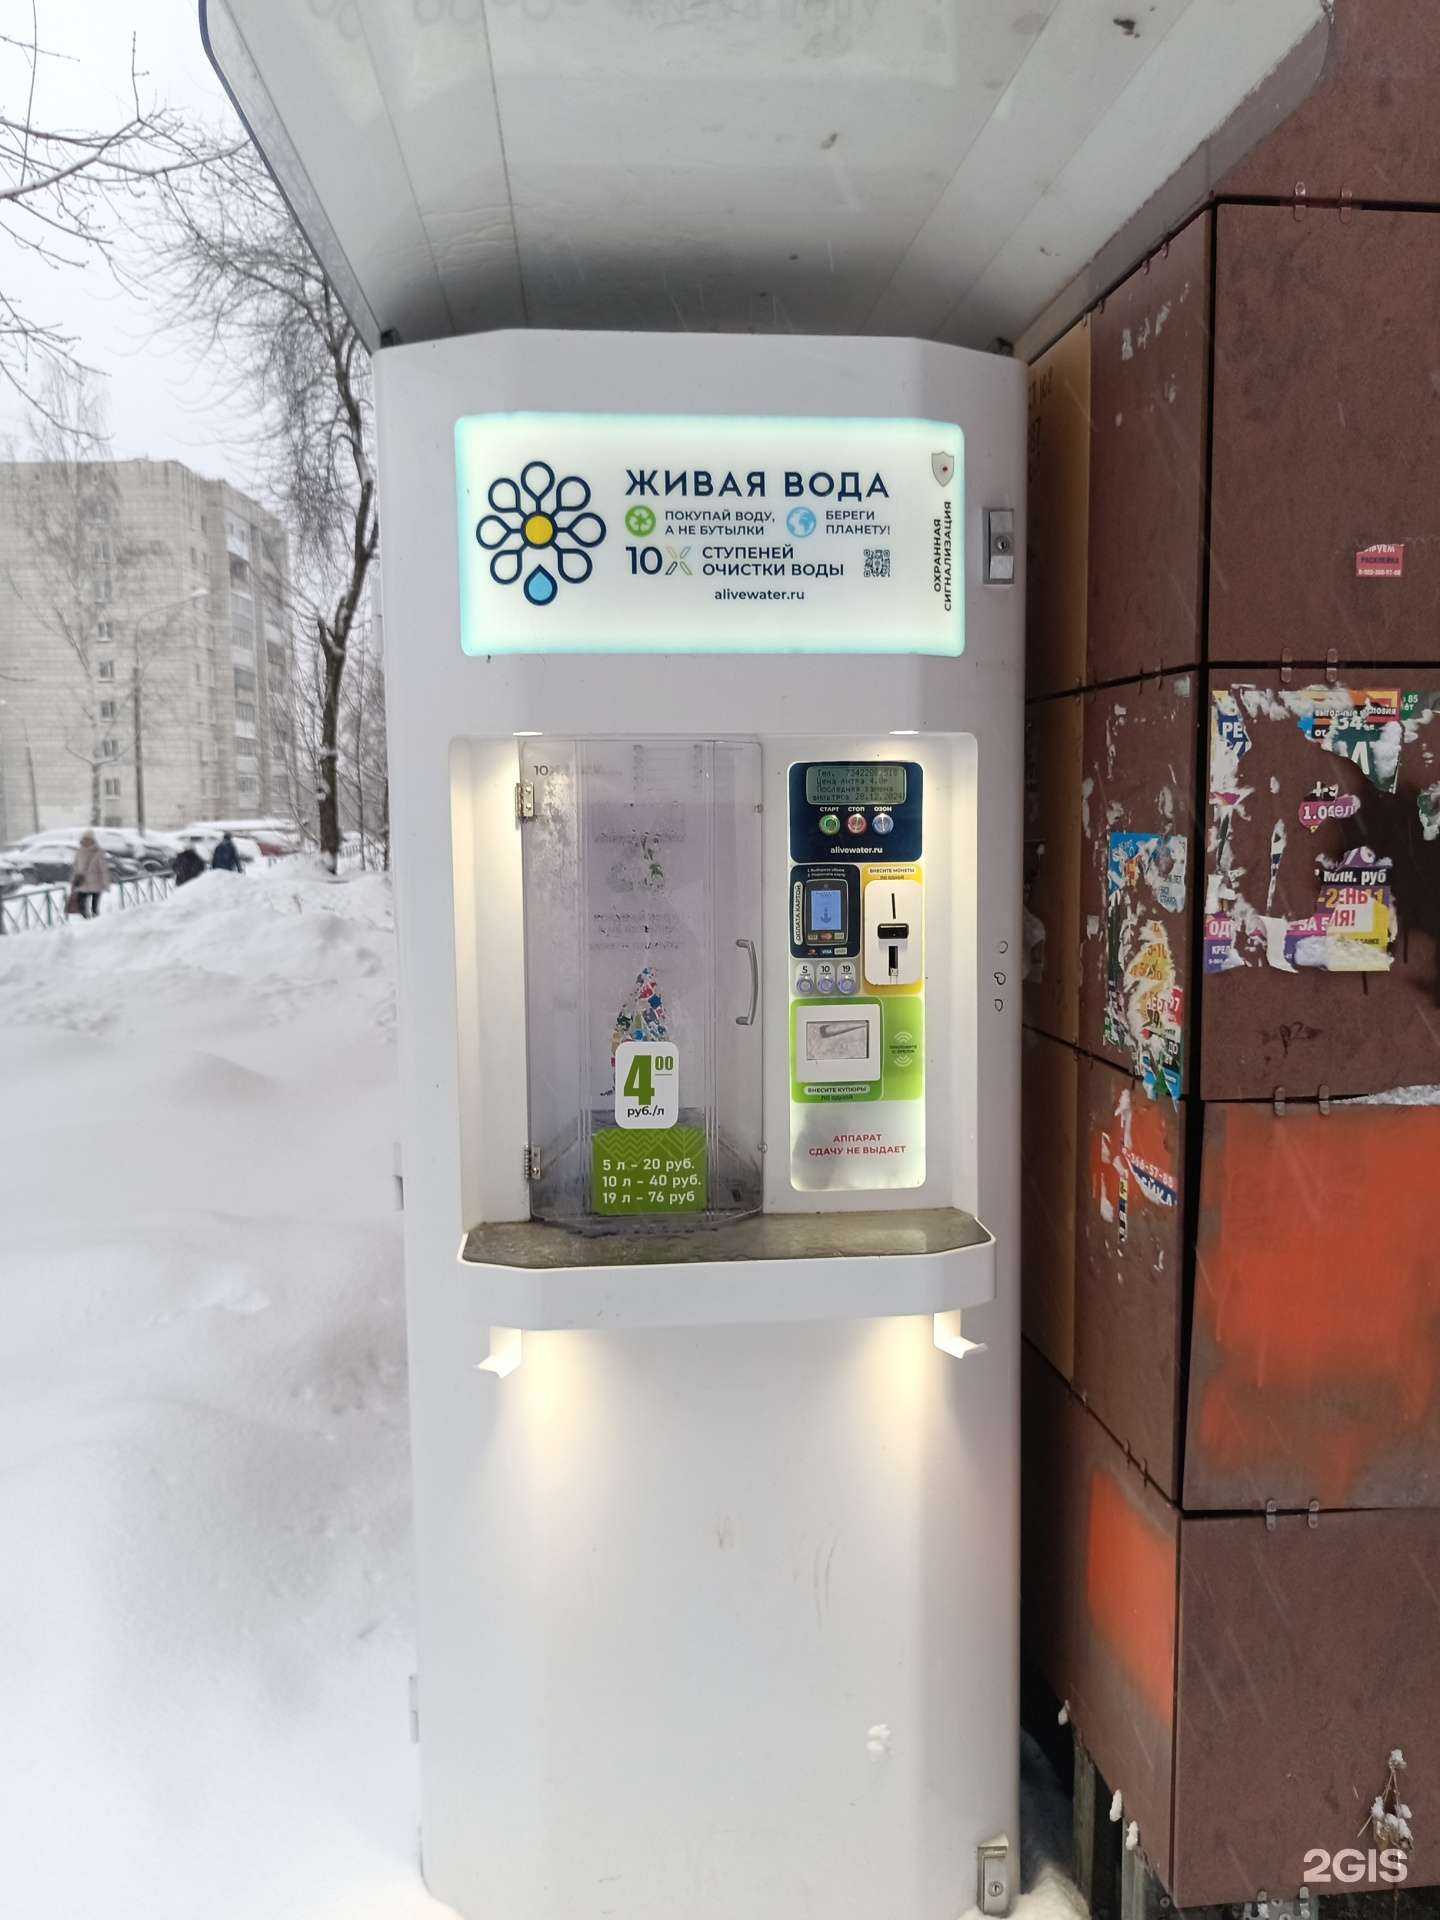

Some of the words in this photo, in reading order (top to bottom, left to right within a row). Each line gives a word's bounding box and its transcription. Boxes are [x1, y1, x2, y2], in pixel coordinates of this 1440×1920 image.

[625, 469, 766, 497] ЖИВАЯ
[784, 471, 889, 502] ВОДА
[665, 509, 731, 521] ПОКУПАЙ
[735, 511, 775, 523] ВОДУ,
[826, 510, 875, 520] БЕРЕГИ
[665, 525, 674, 535] А
[679, 526, 696, 535] НЕ
[700, 526, 764, 535] БУТЫЛКИ
[826, 524, 890, 535] ПЛАНЕТУ!
[702, 544, 794, 559] СТУПЕНЕЙ
[944, 501, 952, 611] СИГНАЛИЗАЦИЯ
[702, 563, 785, 576] ОЧИСТКИ
[791, 563, 844, 577] ВОДЫ
[714, 588, 805, 600] alivewater.ru
[533, 765, 549, 776] 10
[830, 846, 883, 854] alivewater.ru
[802, 965, 808, 973] 5
[821, 965, 830, 973] 10
[842, 965, 850, 973] 19
[623, 1055, 655, 1105] 4
[627, 1105, 665, 1118] руб./л
[833, 1134, 882, 1143] АППАРАТ
[809, 1147, 844, 1156] СДАЧУ
[847, 1146, 860, 1154] НЕ
[863, 1145, 906, 1155] ВЫДАЕТ
[603, 1159, 611, 1171] 5
[616, 1161, 625, 1171] л
[643, 1158, 660, 1170] 20
[666, 1158, 695, 1172] руб.
[602, 1175, 617, 1188] 10
[622, 1178, 631, 1188] л
[649, 1174, 667, 1186] 40
[672, 1174, 701, 1188] руб.
[603, 1192, 616, 1204] 19
[622, 1194, 631, 1203] л
[648, 1191, 664, 1203] 76
[669, 1191, 695, 1205] руб
